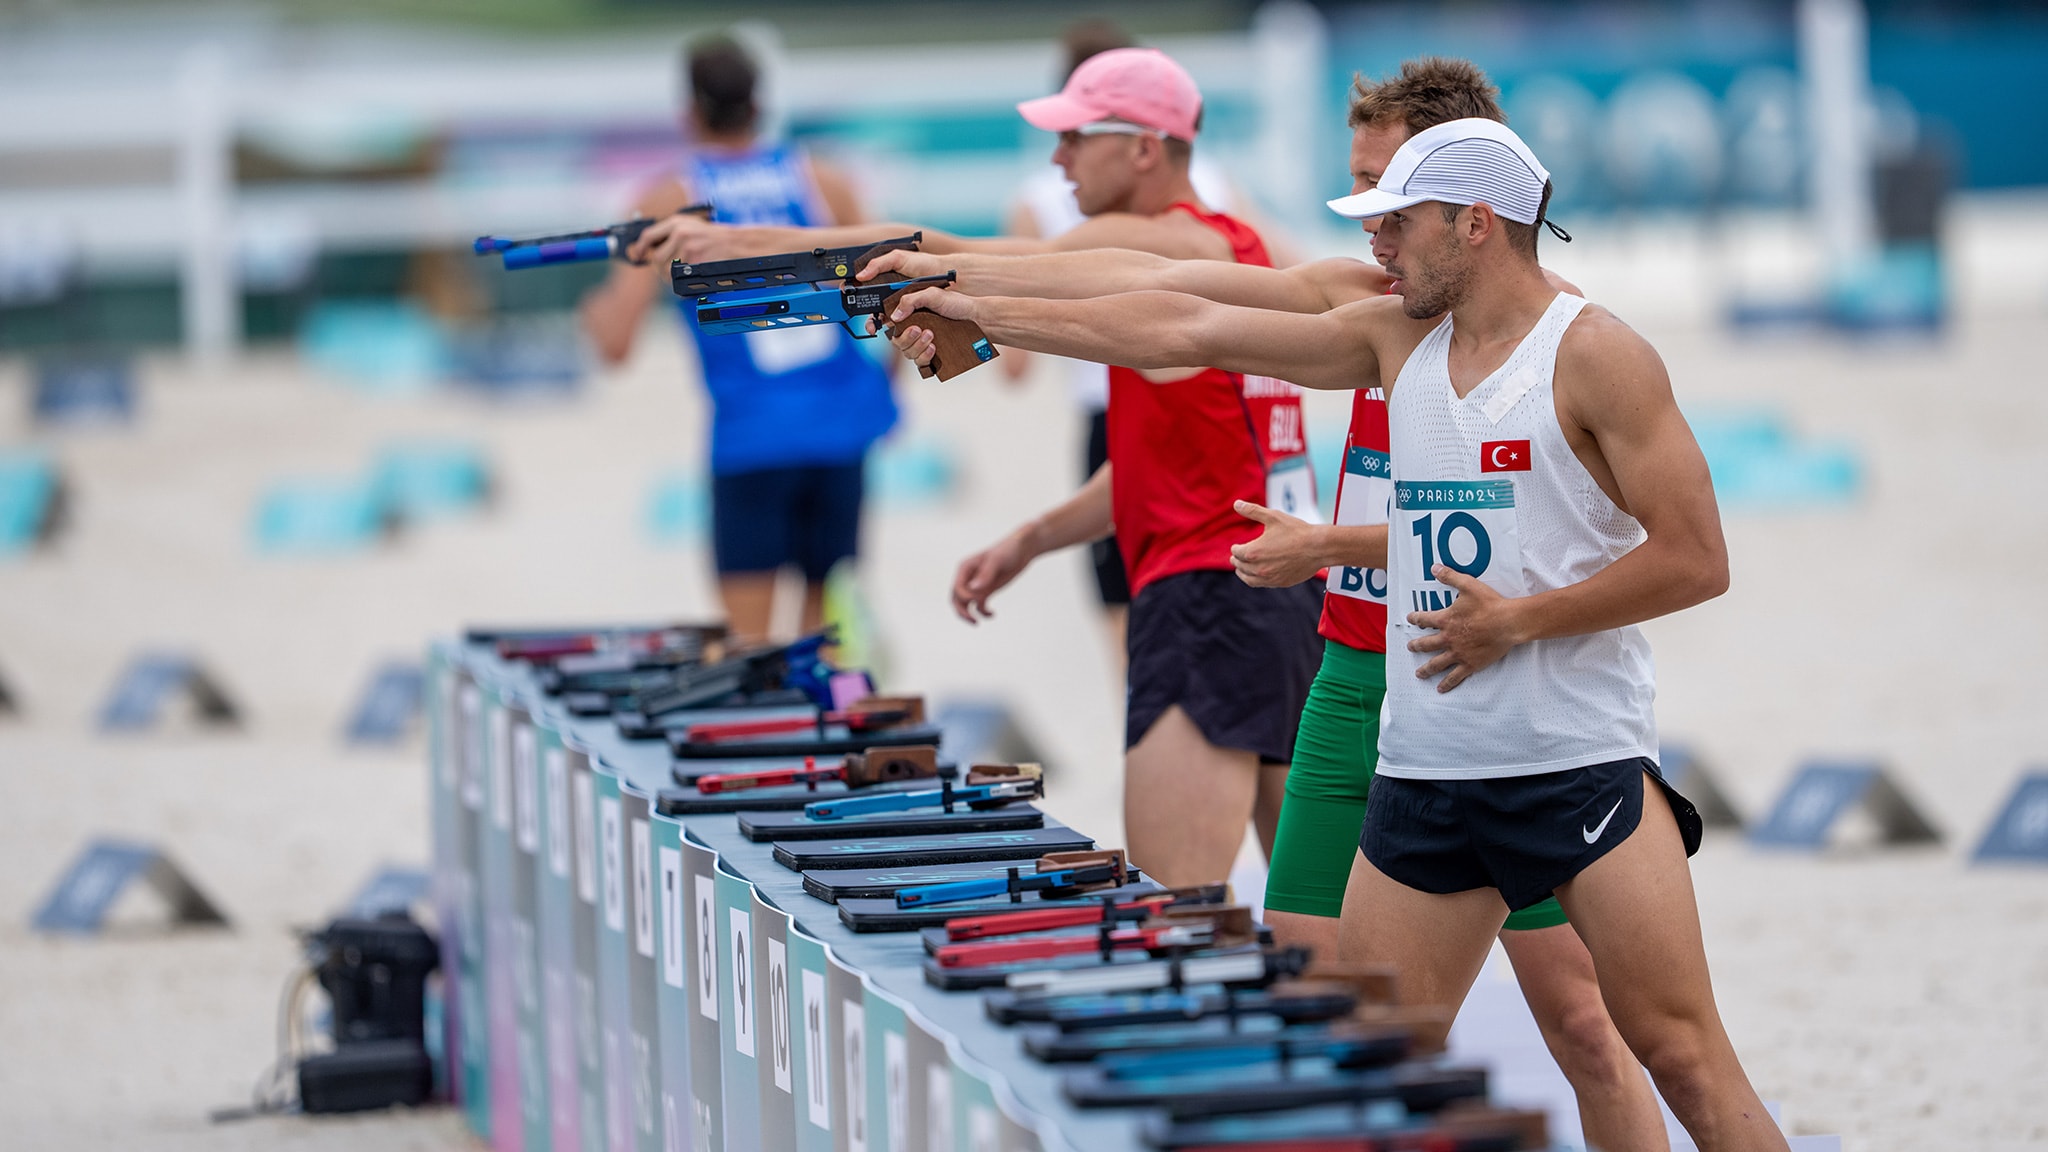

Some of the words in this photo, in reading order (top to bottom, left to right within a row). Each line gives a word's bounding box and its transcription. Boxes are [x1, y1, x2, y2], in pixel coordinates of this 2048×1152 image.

[1412, 511, 1492, 581] 10
[1417, 489, 1454, 502] PARIS
[1458, 488, 1496, 502] 2024
[702, 897, 712, 999] 8
[737, 930, 747, 1035] 9
[771, 962, 788, 1073] 10
[809, 996, 824, 1106] 11
